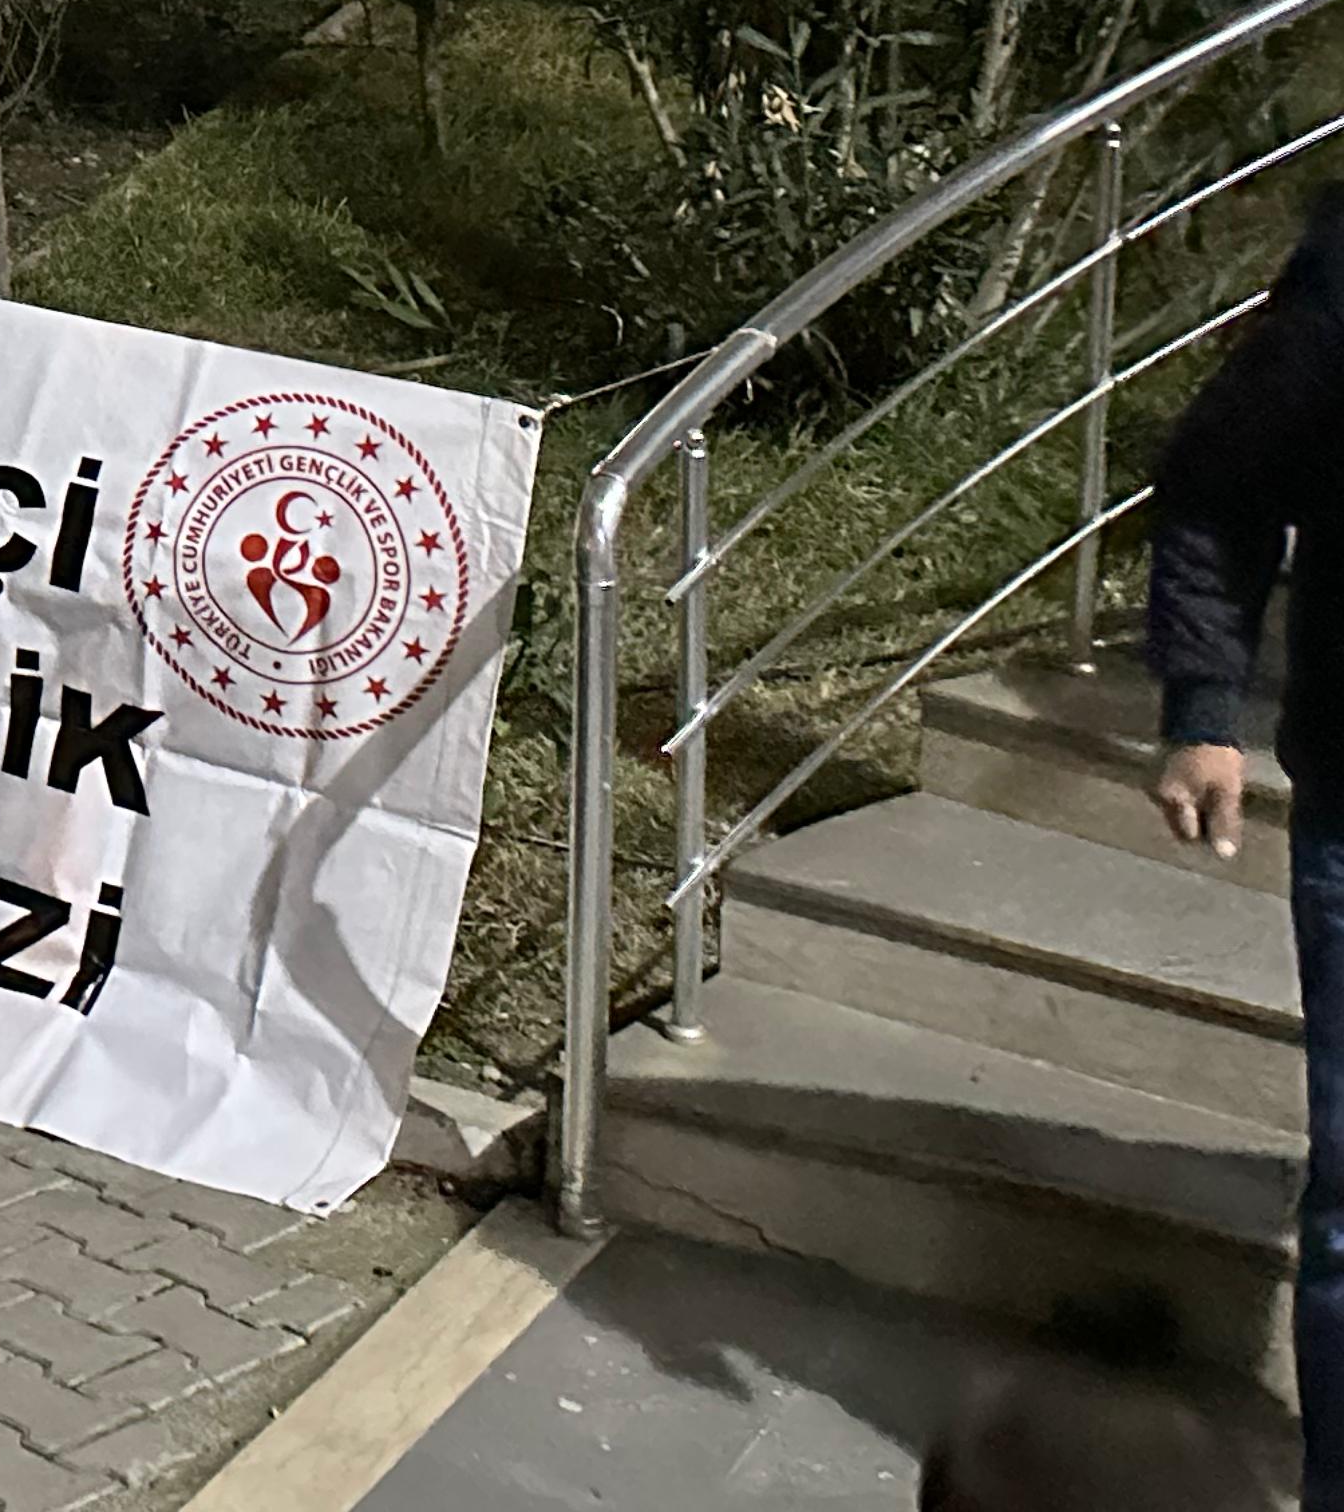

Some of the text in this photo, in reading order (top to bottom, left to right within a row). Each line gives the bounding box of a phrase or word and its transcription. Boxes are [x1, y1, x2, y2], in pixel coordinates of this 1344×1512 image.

[181, 453, 274, 574] CUMHURİYETİ
[279, 454, 369, 503] GENÇLİK
[363, 497, 389, 529] VE
[376, 531, 401, 593] SPOR
